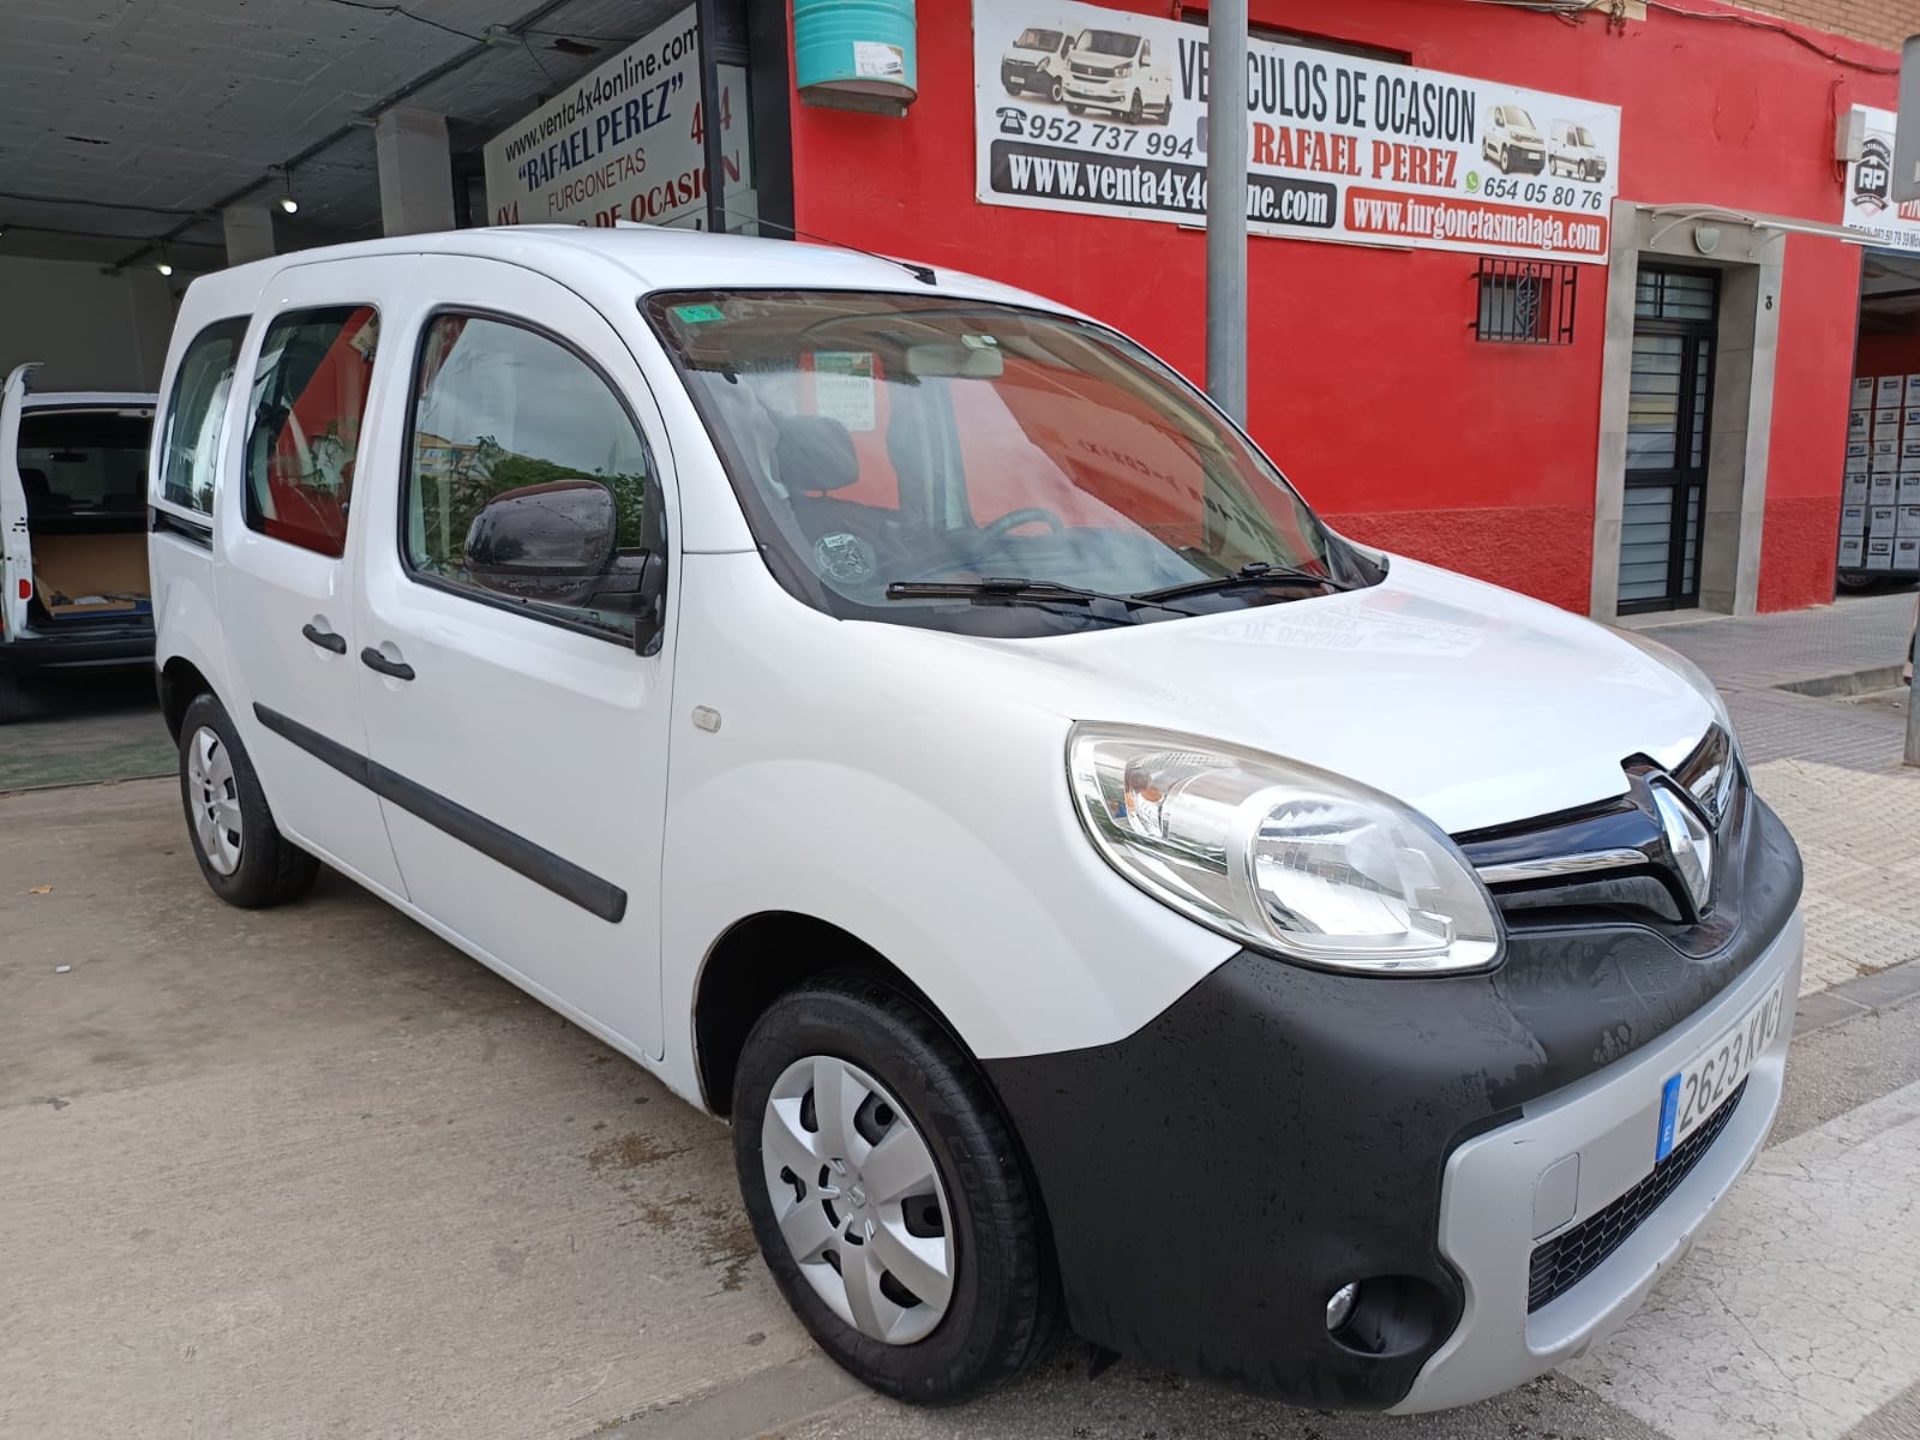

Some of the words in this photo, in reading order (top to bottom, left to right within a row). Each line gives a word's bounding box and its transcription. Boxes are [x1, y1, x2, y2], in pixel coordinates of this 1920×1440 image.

[505, 25, 698, 162] www.venta4x4online.com
[1178, 38, 1327, 122] VECULOS
[1336, 68, 1367, 128] DE
[1375, 77, 1476, 144] OCASION
[548, 147, 646, 216] FURGONETAS
[690, 86, 732, 145] 44
[1028, 114, 1081, 145] 952
[1091, 123, 1139, 152] 737
[1146, 132, 1194, 160] 994
[1252, 122, 1362, 176] RAFAEL
[1372, 139, 1458, 188] PEREZ
[1008, 154, 1328, 223] www.venta4x4ne.com
[1484, 177, 1518, 200] 654
[1524, 183, 1547, 204] 05
[1552, 187, 1575, 207] 80
[1580, 190, 1602, 211] 76
[1859, 166, 1885, 190] RP
[1353, 197, 1600, 250] www.furgonetasmalaga.com
[1679, 1032, 1743, 1133] 2623
